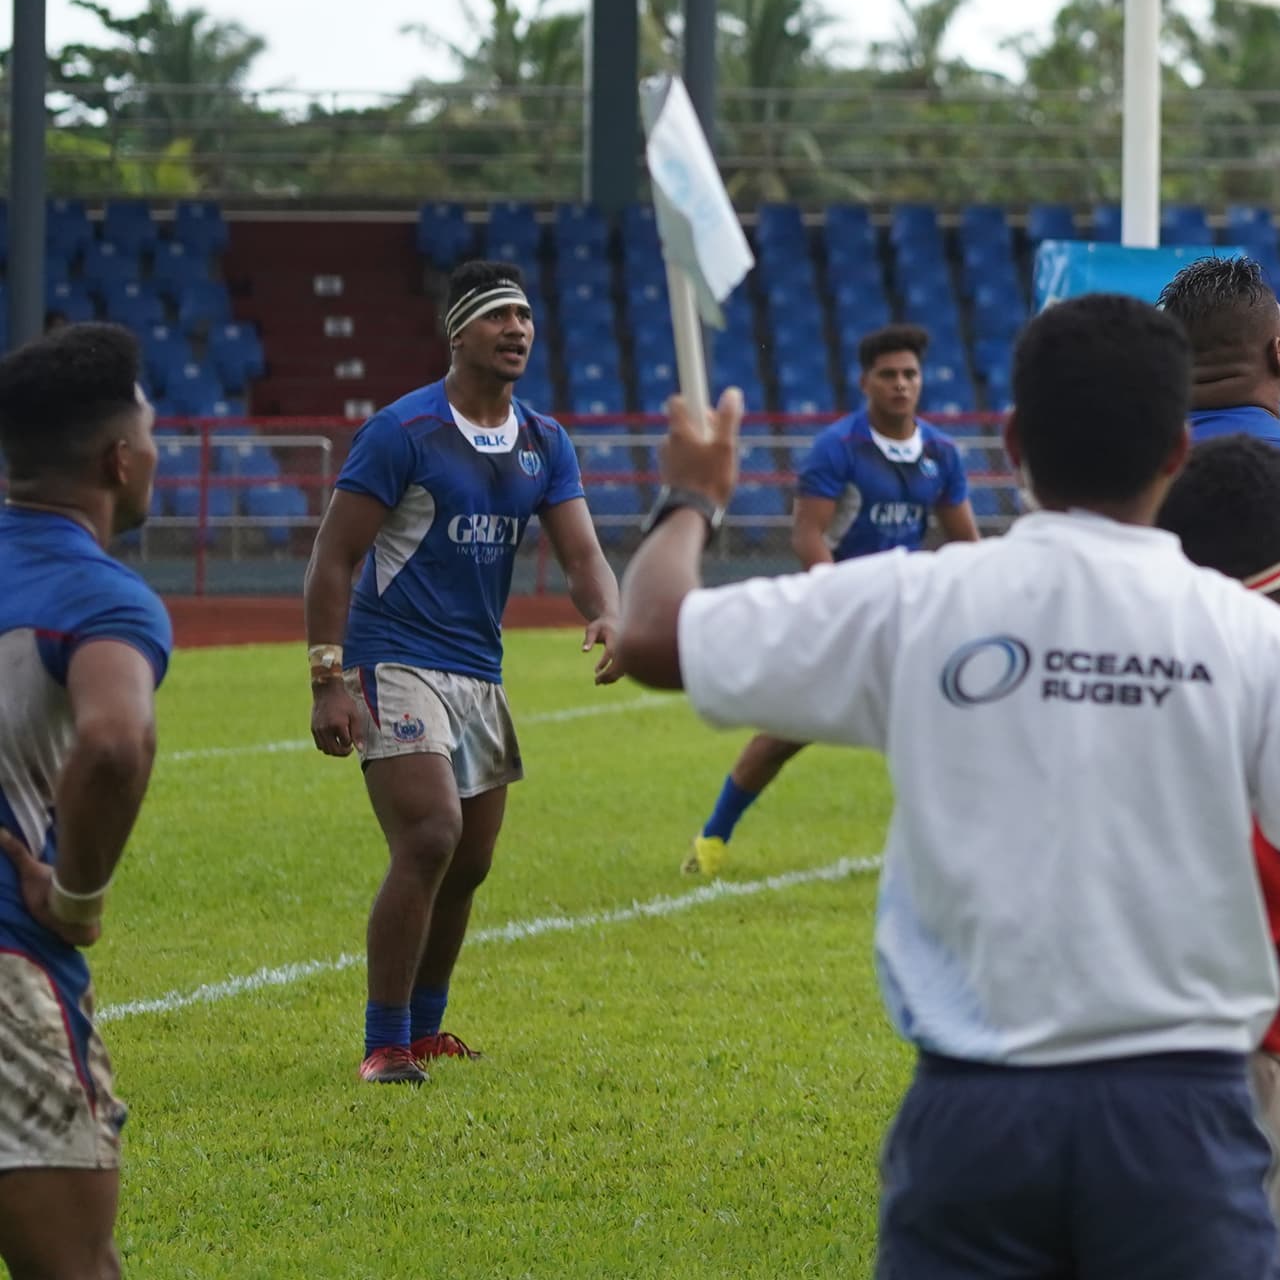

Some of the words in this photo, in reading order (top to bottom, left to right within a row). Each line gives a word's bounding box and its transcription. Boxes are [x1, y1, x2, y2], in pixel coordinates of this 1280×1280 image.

[473, 435, 508, 446] BLK
[1044, 650, 1212, 684] OCEANIA
[1041, 678, 1171, 707] RUGBY
